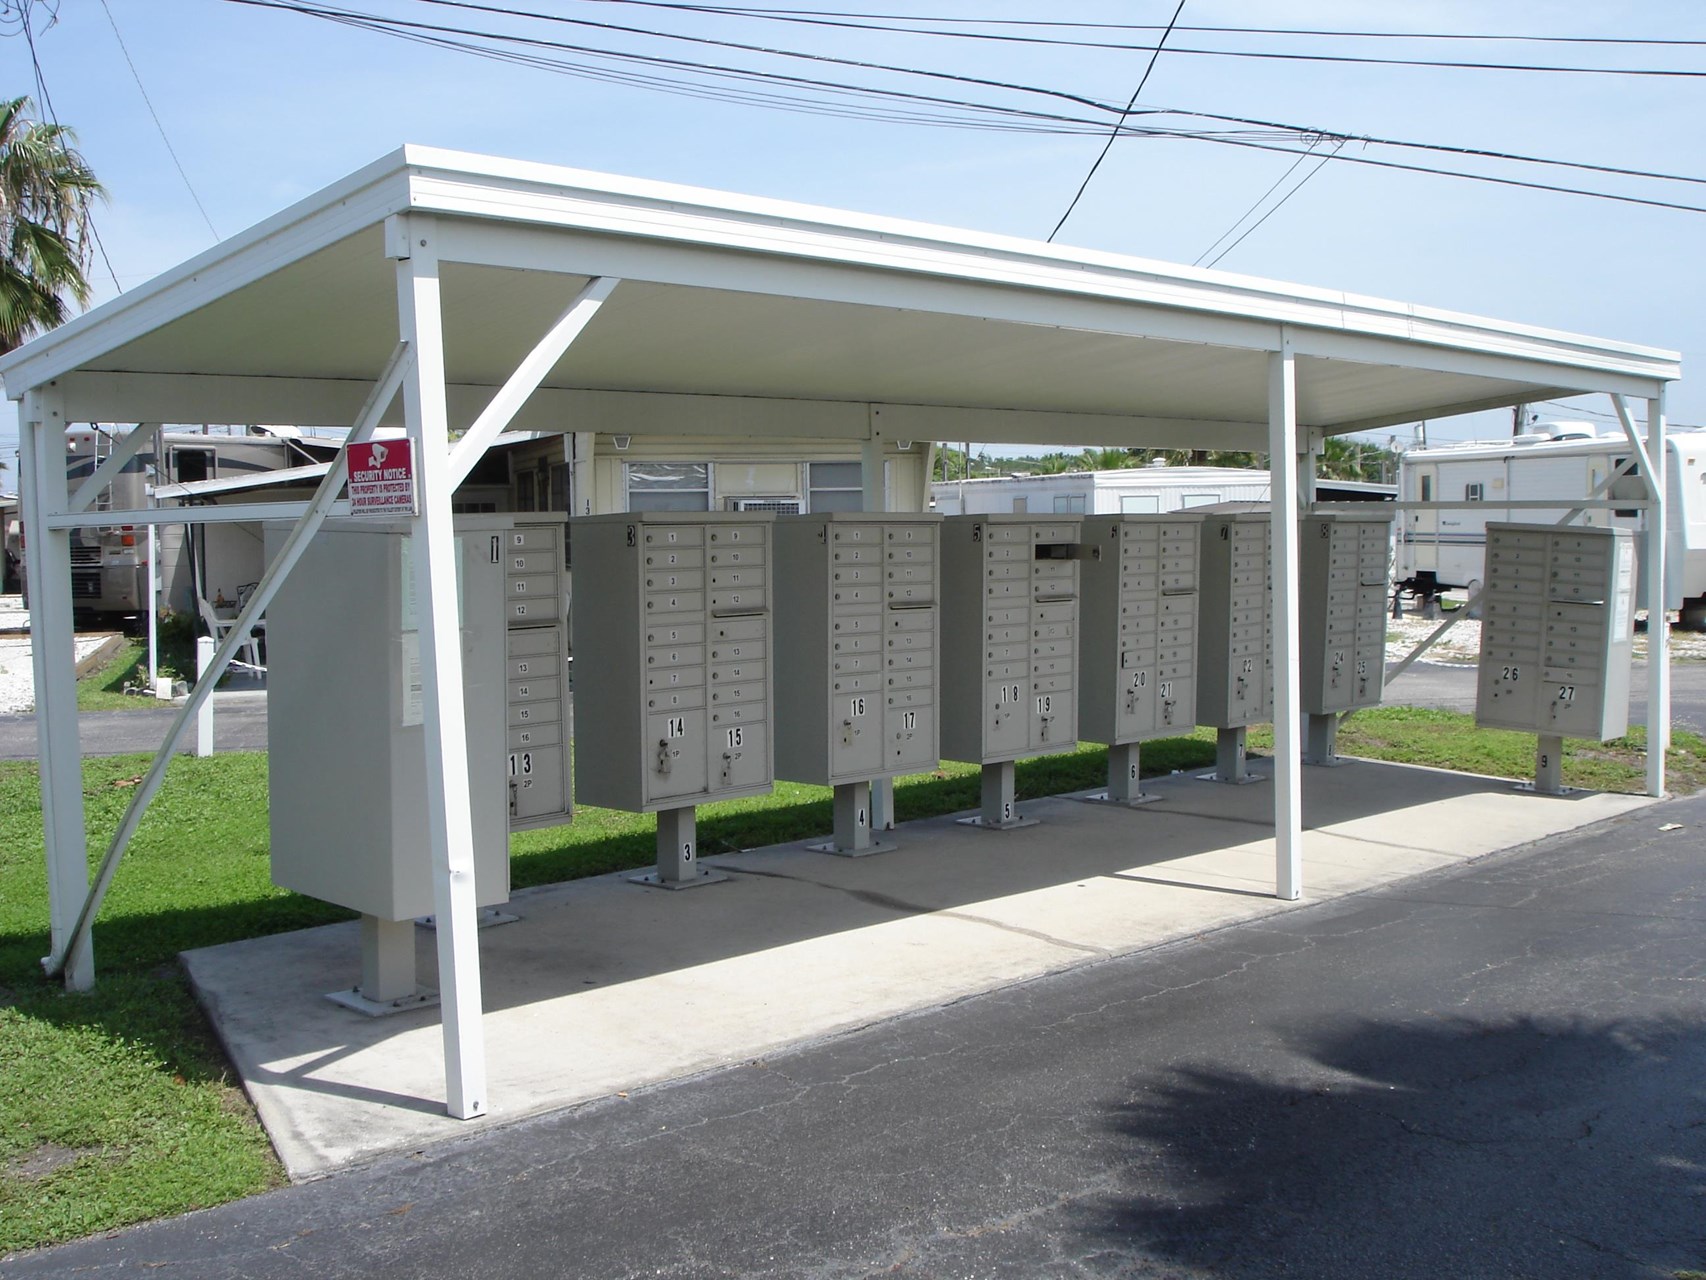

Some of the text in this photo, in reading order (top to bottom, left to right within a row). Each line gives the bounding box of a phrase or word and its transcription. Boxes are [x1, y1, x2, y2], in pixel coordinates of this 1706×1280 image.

[353, 467, 407, 482] SECURITY NOTICE
[627, 525, 635, 547] 3
[973, 523, 980, 542] 5
[1321, 523, 1329, 538] 8
[516, 536, 522, 544] 9
[516, 560, 524, 568] 10
[517, 583, 525, 591] 11
[517, 606, 525, 614] 12
[1335, 652, 1343, 665] 24
[519, 664, 528, 672] 13
[1357, 661, 1365, 674] 25
[1503, 667, 1518, 681] 26
[1134, 672, 1145, 687] 20
[520, 687, 528, 695] 14
[1003, 686, 1018, 702] 18
[1161, 683, 1171, 697] 21
[1559, 687, 1574, 700] 27
[853, 699, 864, 716] 16
[1039, 697, 1050, 713] 19
[521, 710, 529, 718] 15
[904, 712, 914, 729] 17
[670, 718, 683, 737] 14
[522, 733, 529, 741] 16
[729, 728, 741, 747] 15
[510, 753, 531, 775] 13
[1542, 755, 1547, 768] 9
[1132, 765, 1135, 779] 6
[523, 780, 532, 788] 2P
[859, 809, 864, 826] 4
[1005, 803, 1010, 819] 5
[685, 844, 690, 861] 3
